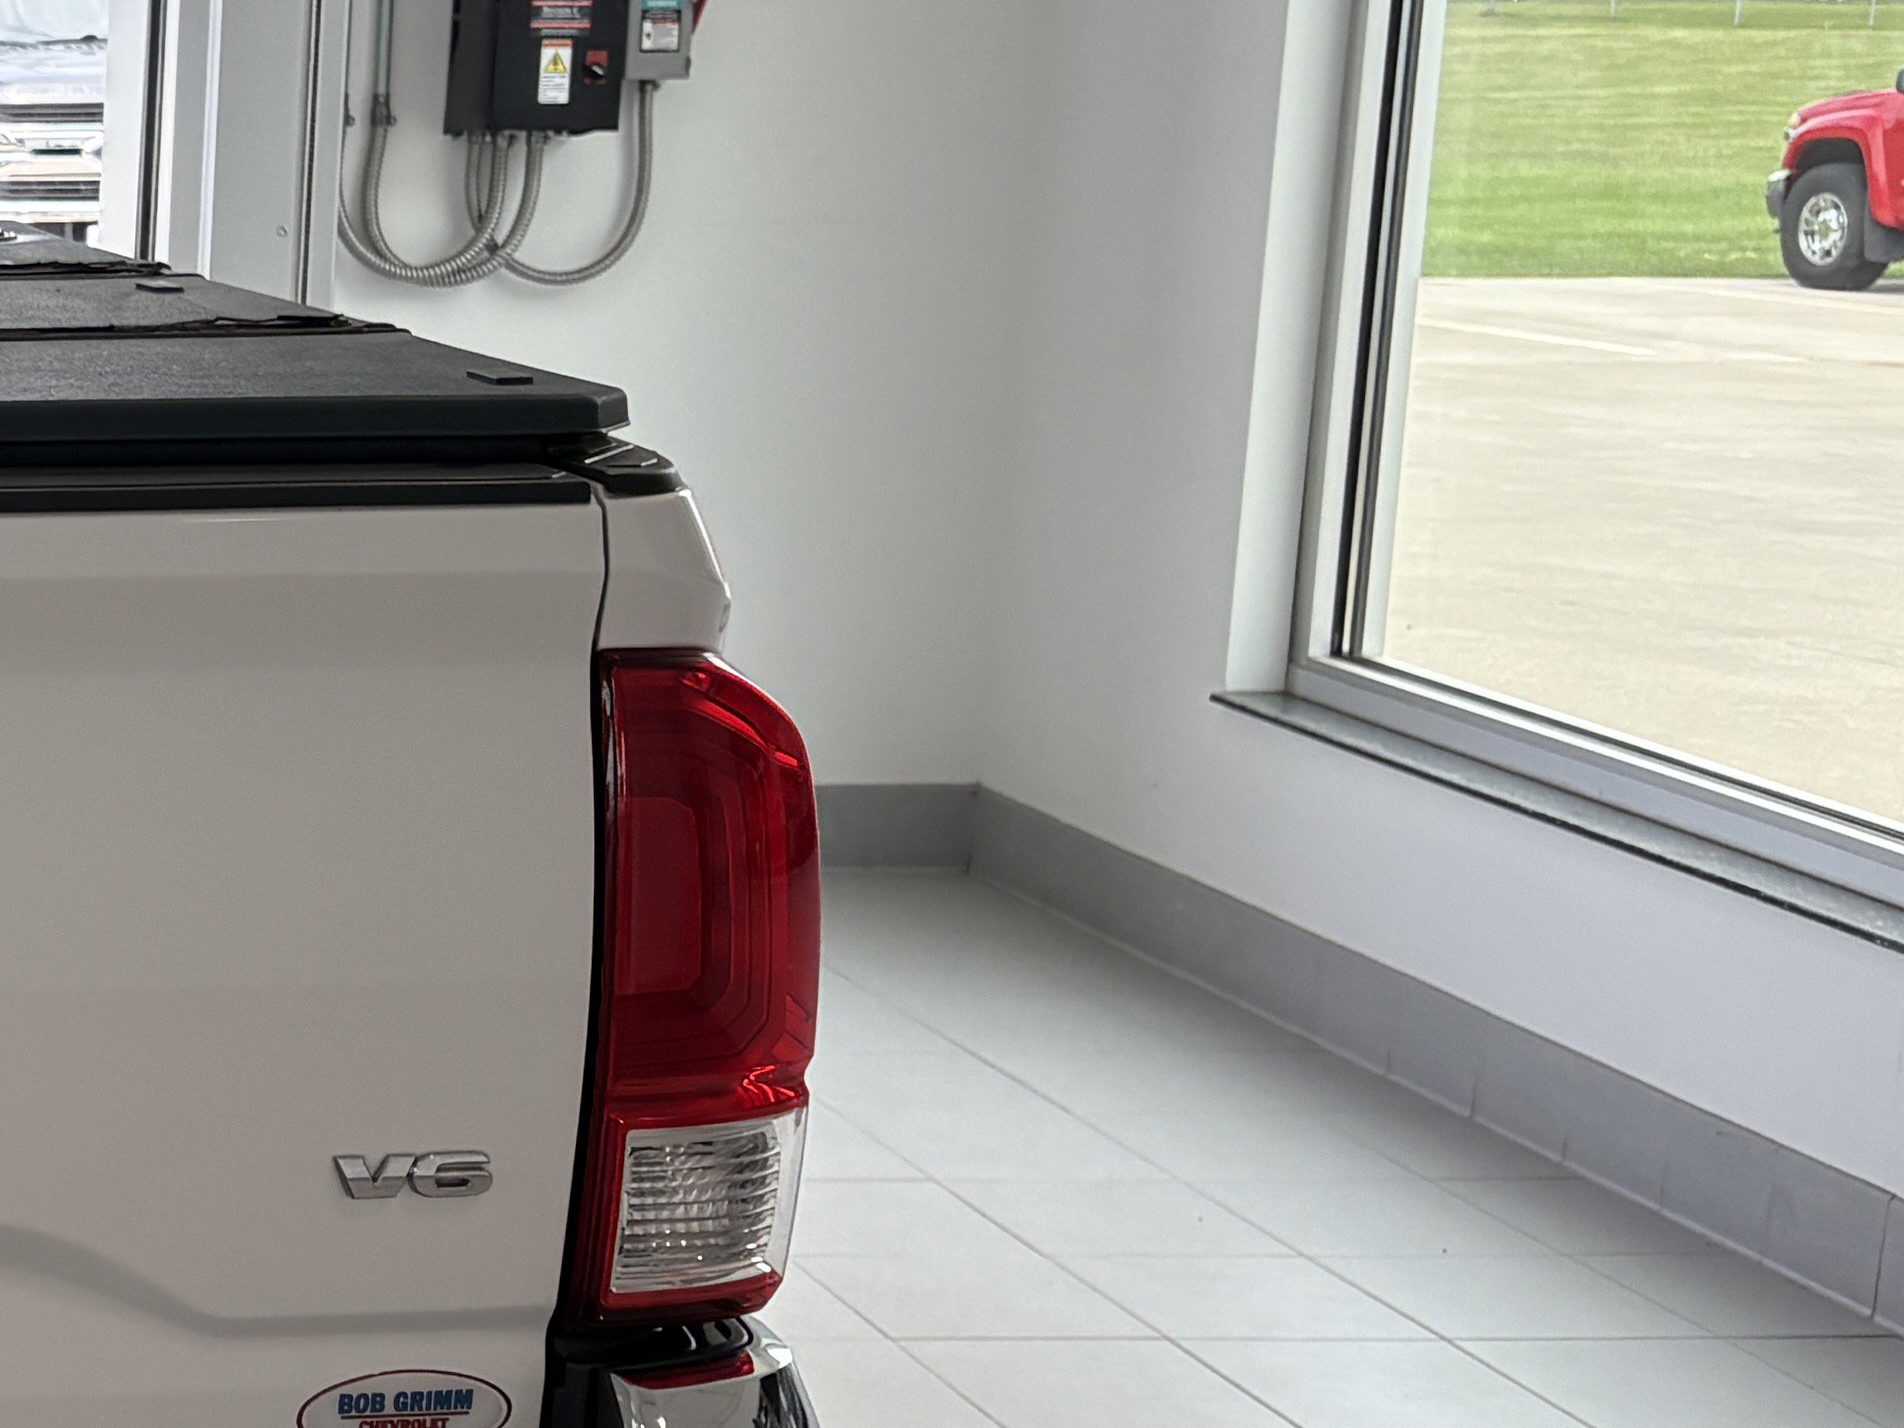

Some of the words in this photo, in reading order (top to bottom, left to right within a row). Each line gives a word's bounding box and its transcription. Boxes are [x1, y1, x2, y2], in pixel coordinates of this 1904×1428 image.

[333, 1150, 492, 1200] V6
[338, 1392, 386, 1414] BOB
[393, 1388, 474, 1412] GRIMM
